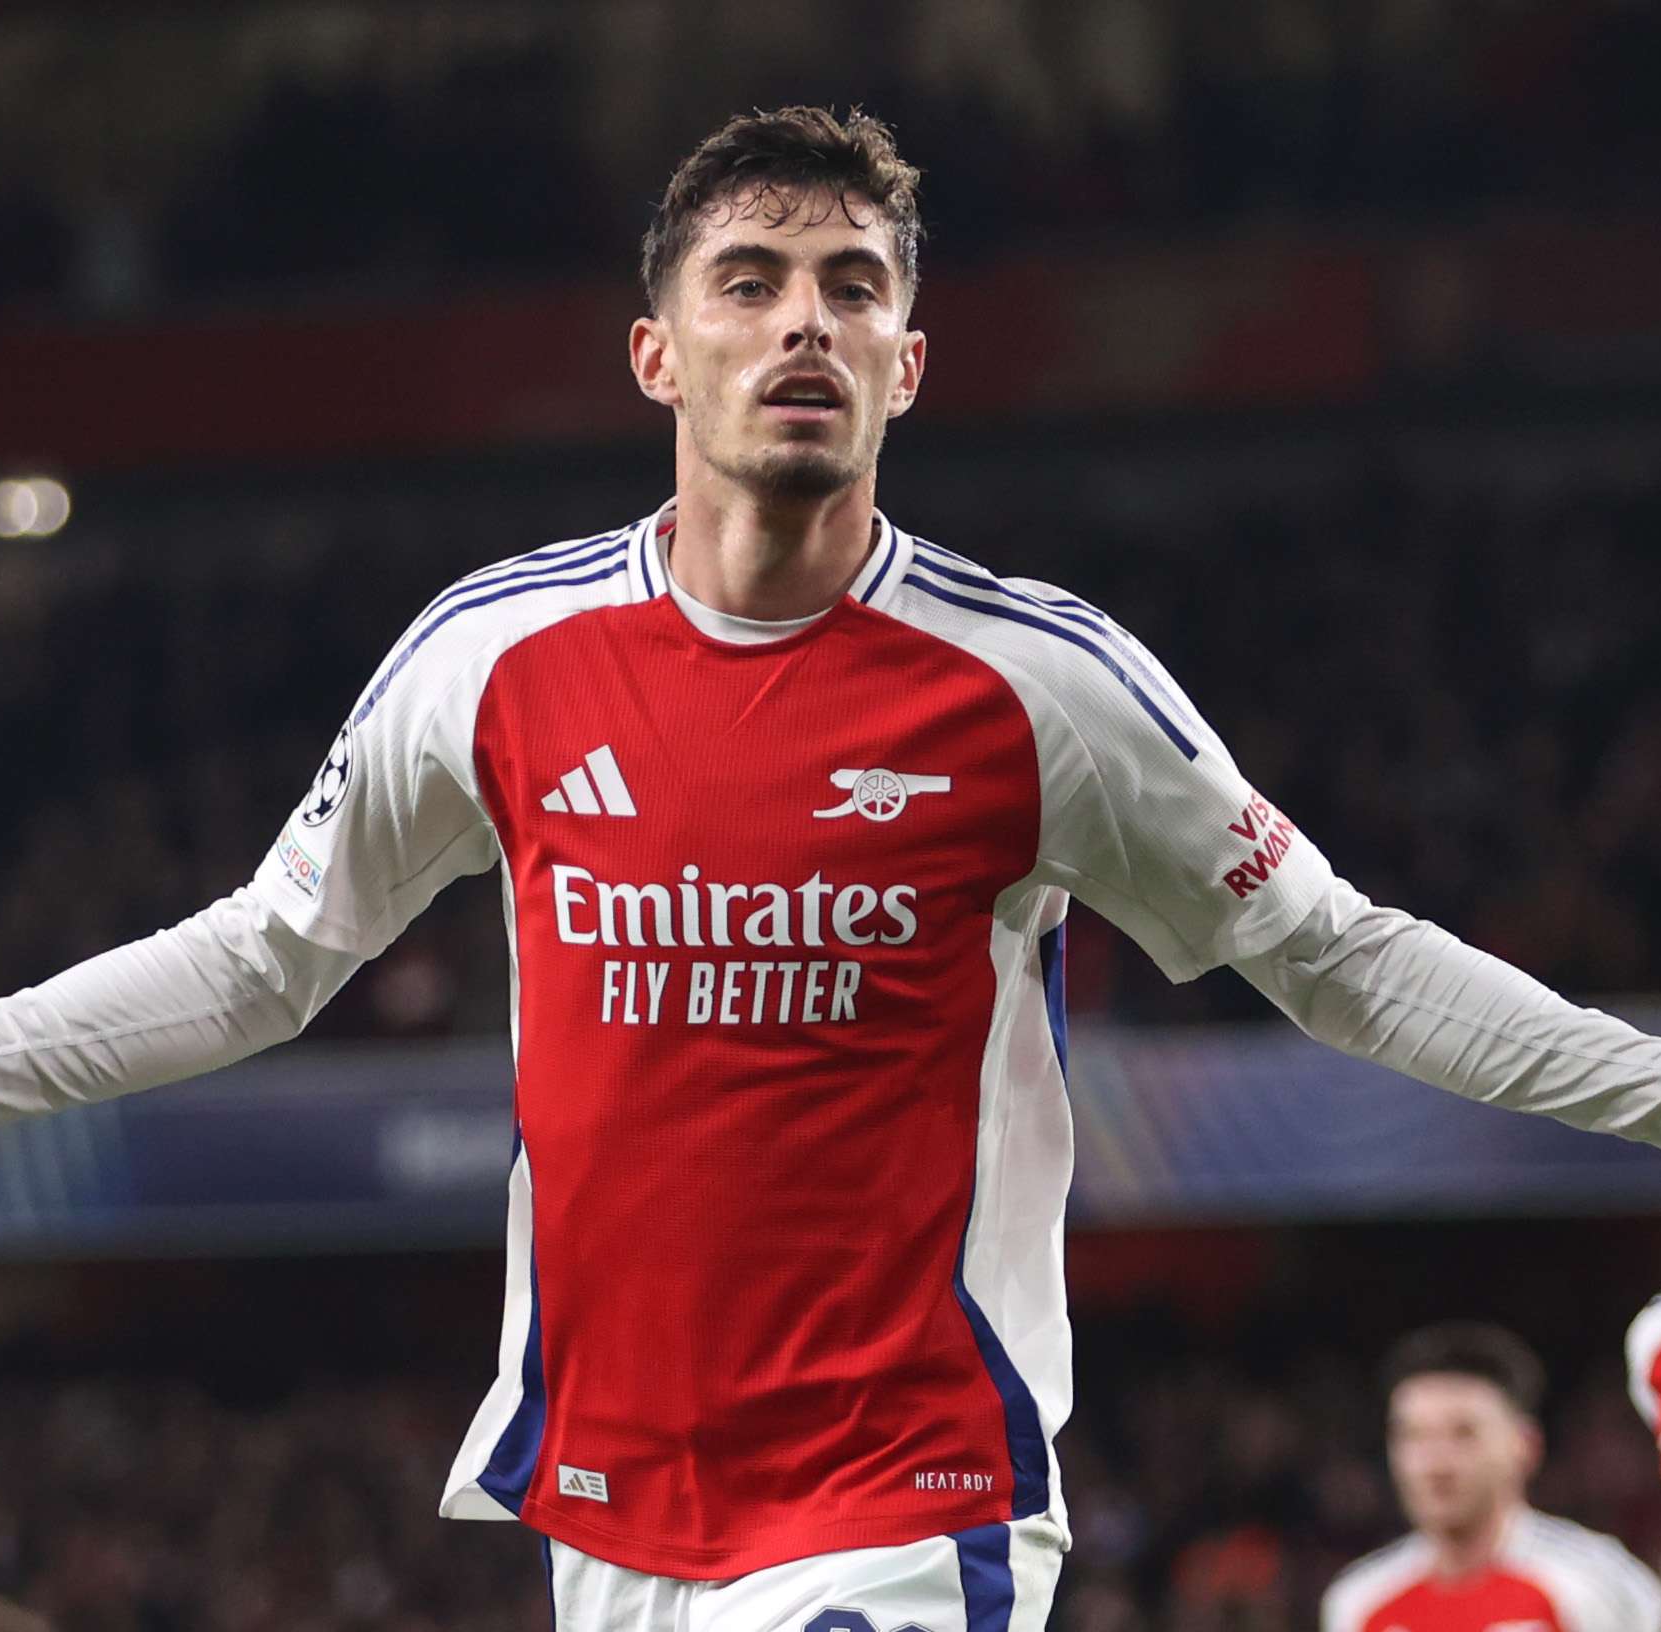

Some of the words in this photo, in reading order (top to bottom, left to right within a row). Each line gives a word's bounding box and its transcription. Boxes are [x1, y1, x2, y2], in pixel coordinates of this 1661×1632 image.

[551, 864, 918, 947] Emirates
[601, 960, 670, 1024] FLY
[686, 960, 862, 1024] BETTER
[915, 1472, 993, 1492] HEAT.RDY
